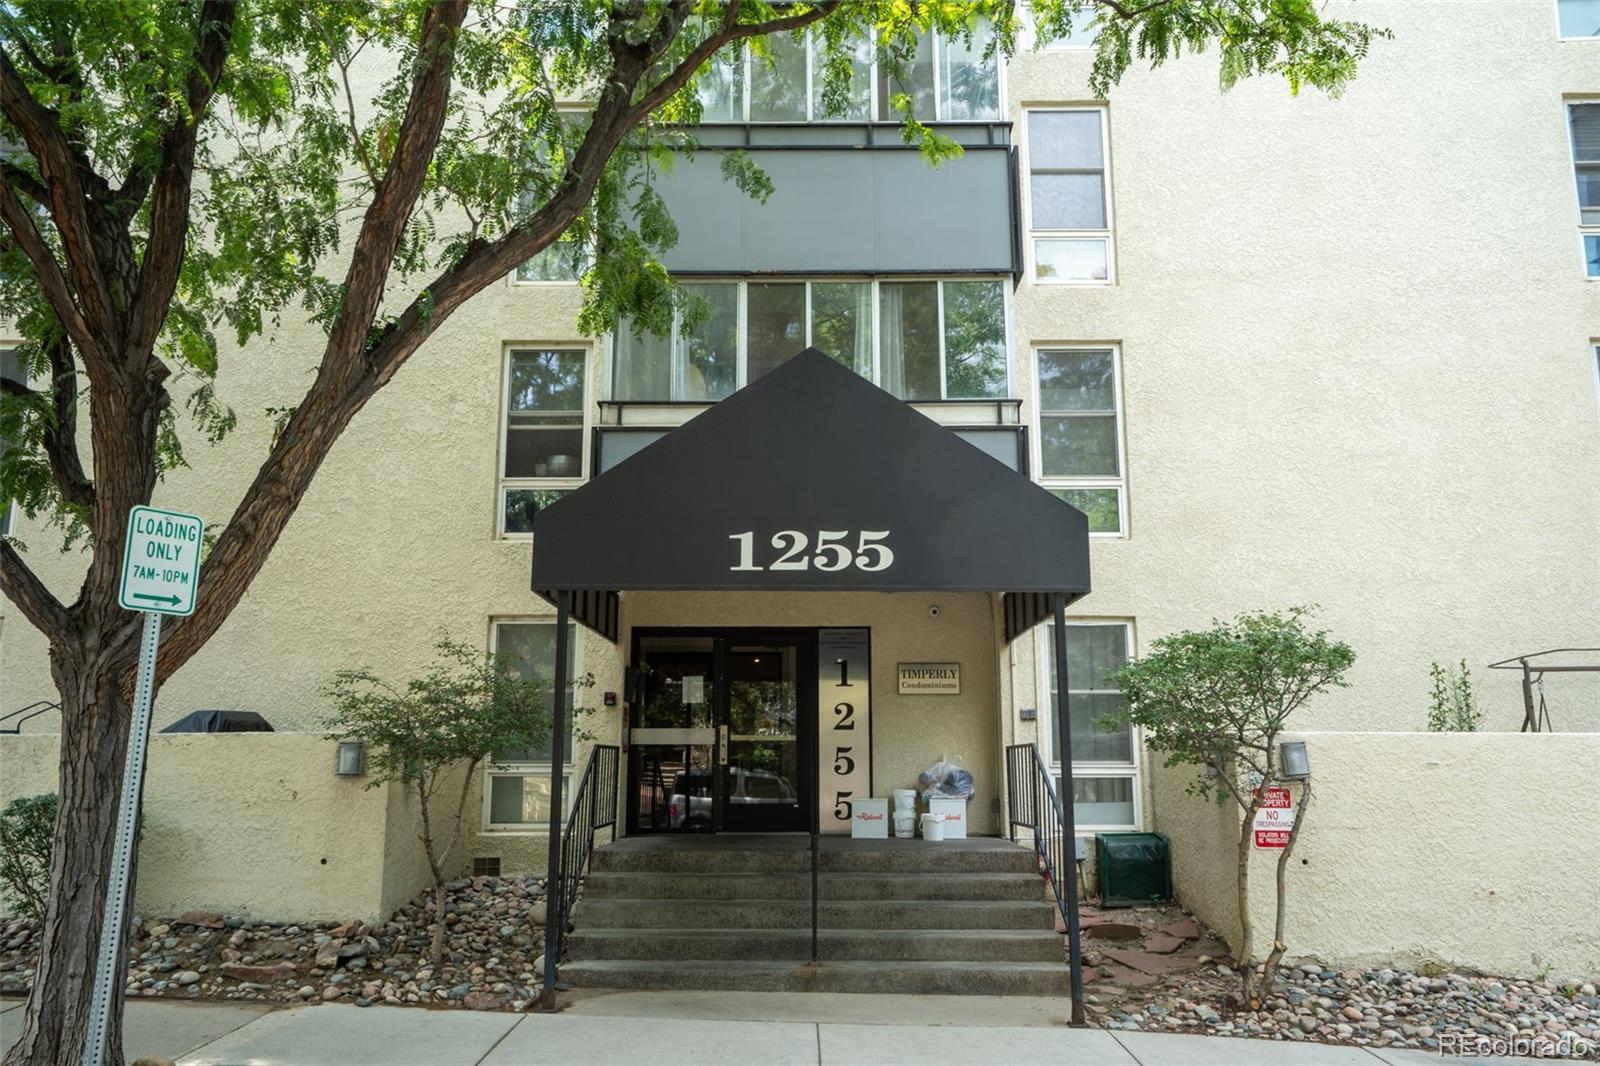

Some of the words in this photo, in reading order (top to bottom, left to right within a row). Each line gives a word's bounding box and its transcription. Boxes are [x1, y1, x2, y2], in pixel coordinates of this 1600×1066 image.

[136, 516, 197, 542] LOADING
[146, 540, 182, 561] ONLY
[728, 529, 894, 572] 1255
[133, 564, 189, 584] 7AM-10PM
[900, 669, 957, 680] TIMPERLY
[901, 680, 957, 689] Condominiums
[1266, 811, 1278, 820] NO
